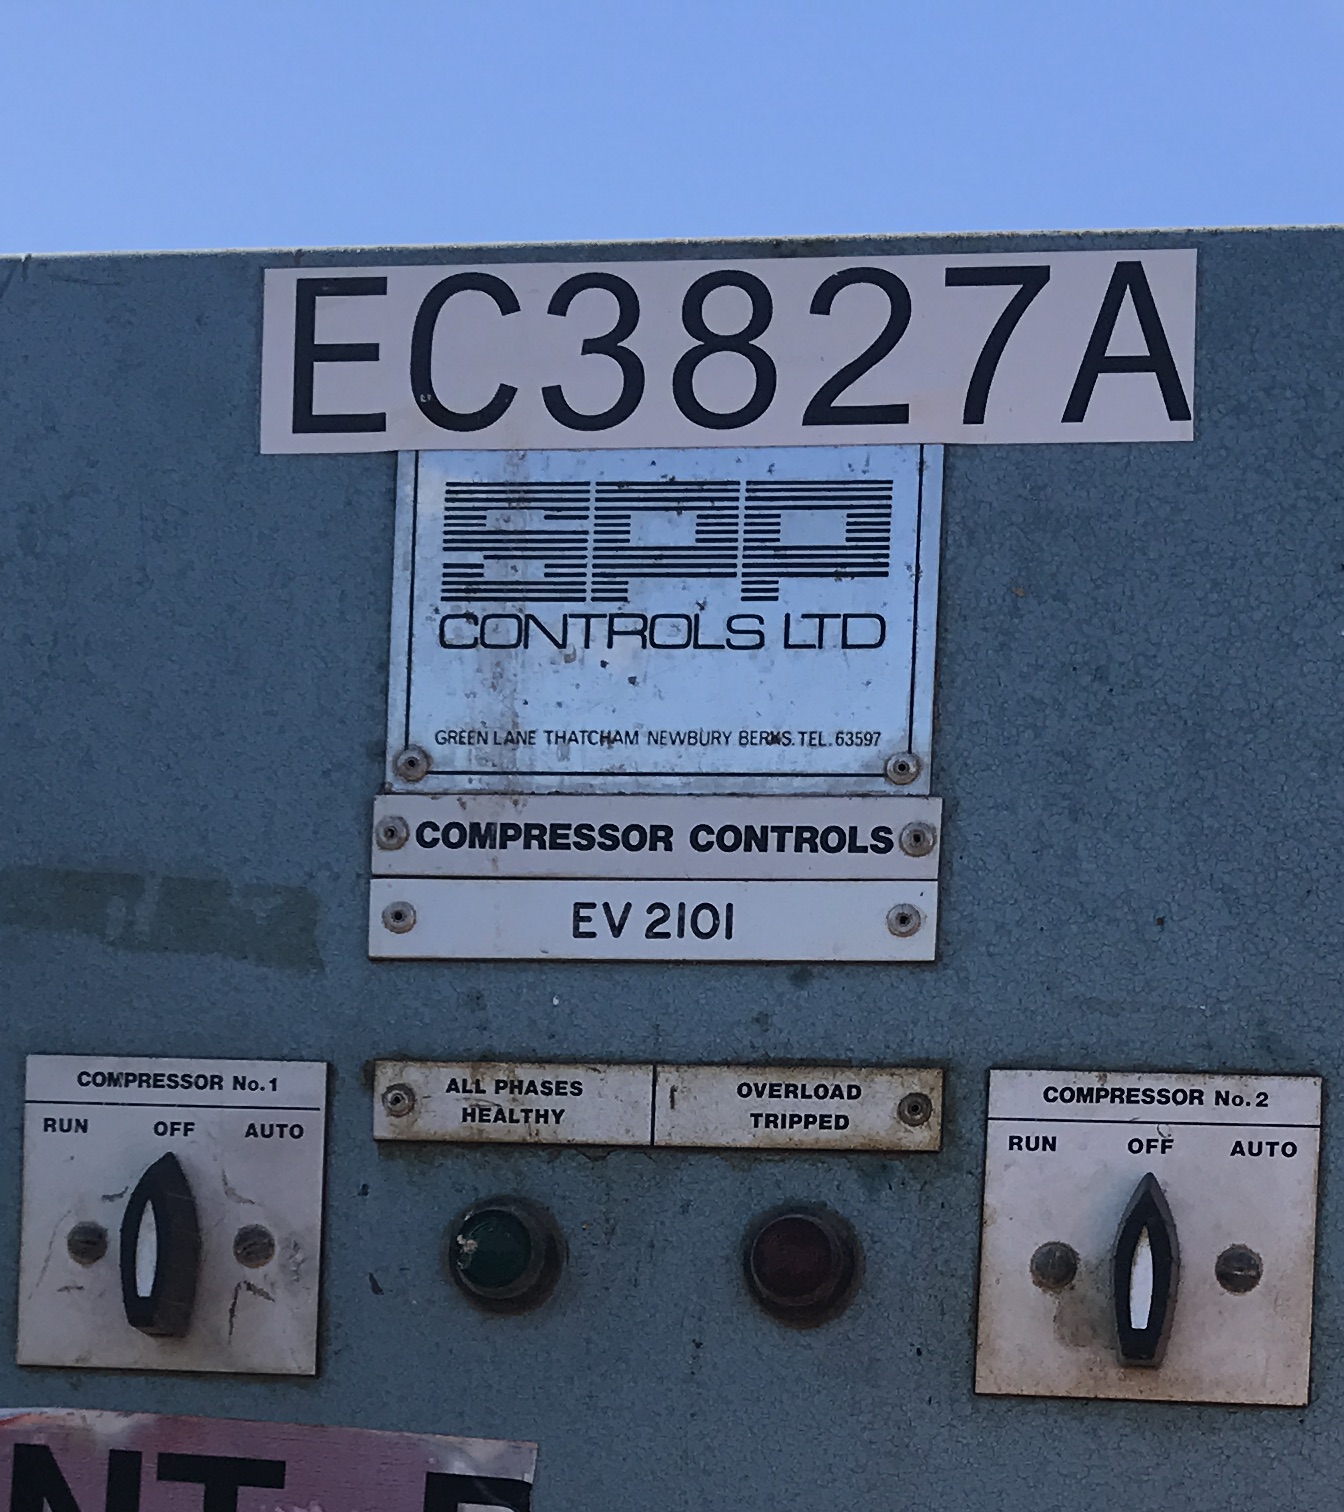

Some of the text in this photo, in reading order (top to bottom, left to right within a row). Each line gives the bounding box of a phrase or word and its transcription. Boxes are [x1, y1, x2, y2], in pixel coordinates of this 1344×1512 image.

[291, 259, 1193, 435] EC3827A
[438, 612, 887, 651] CONTROLS LTD
[434, 729, 489, 746] GREEN
[493, 729, 536, 746] LANE
[544, 730, 640, 747] THATCHAM
[647, 730, 732, 747] NEWBURY
[834, 731, 882, 748] 63597
[415, 820, 895, 855] COMPRESSOR CONTROLS
[571, 901, 735, 940] EV 2101
[76, 1069, 224, 1092] COMPRESSOR
[445, 1077, 584, 1098] ALL PHASES
[735, 1081, 863, 1102] OVERLOAD
[1042, 1085, 1205, 1107] COMPRESSOR
[460, 1106, 566, 1126] HEALTHY
[749, 1111, 851, 1132] TRIPPED
[42, 1117, 305, 1141] RUN OFF AUTO
[1007, 1134, 1299, 1158] RUN OFF AUTO
